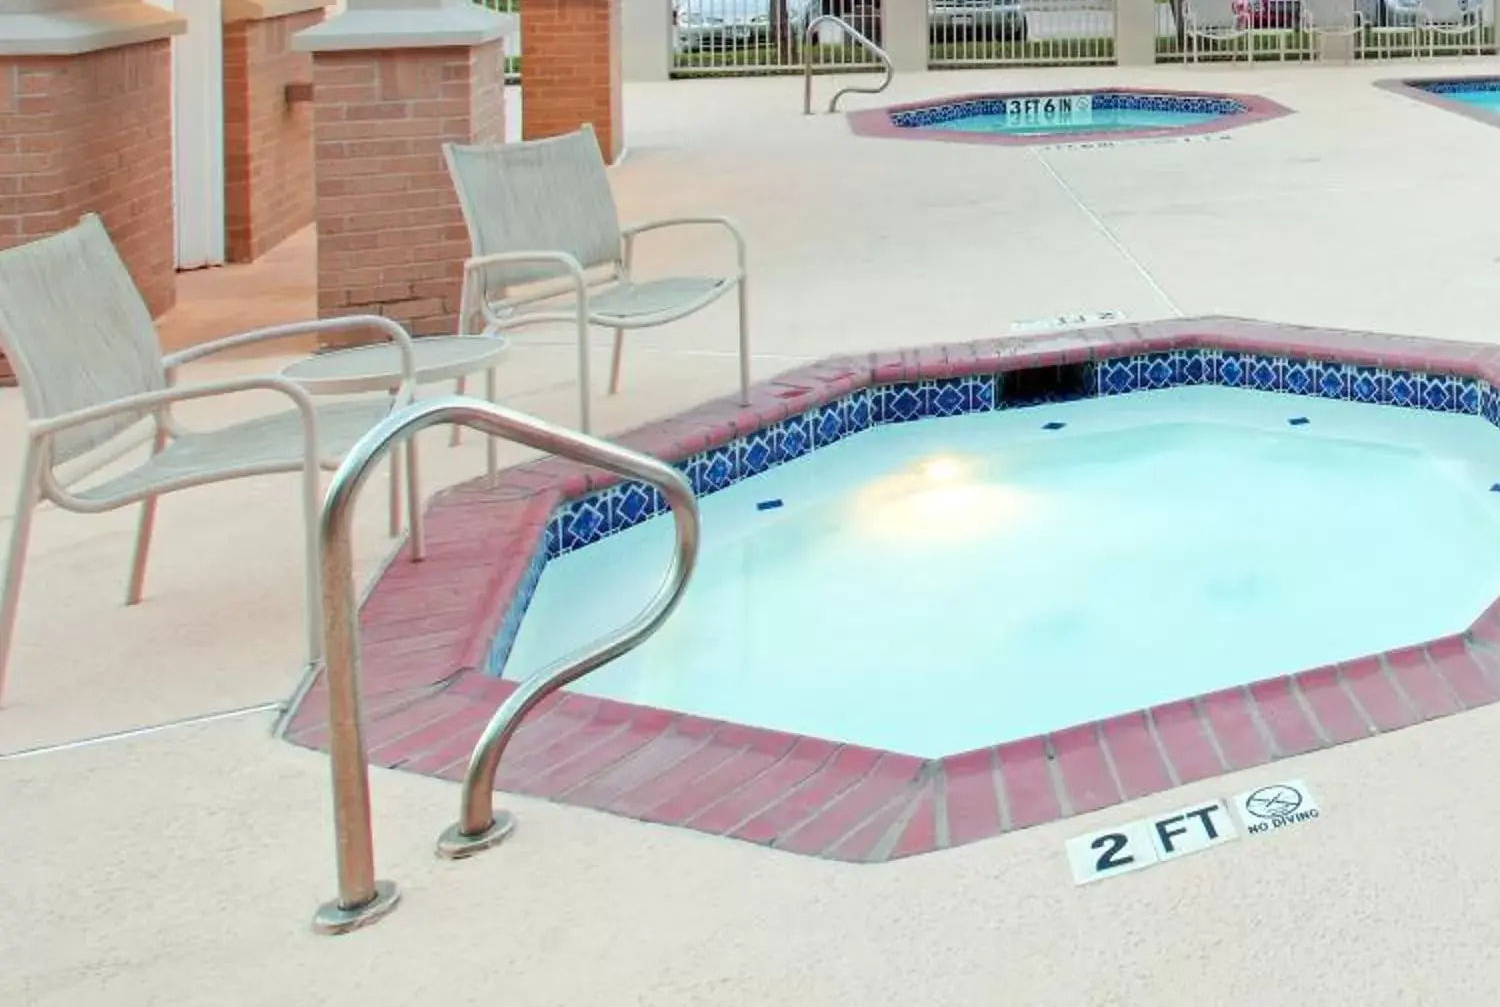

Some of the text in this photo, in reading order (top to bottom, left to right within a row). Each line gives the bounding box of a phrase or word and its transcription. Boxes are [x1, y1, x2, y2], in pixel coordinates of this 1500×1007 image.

[1010, 98, 1072, 113] 3 FT 6 IN
[1247, 807, 1320, 835] NO DIVING
[1090, 803, 1220, 872] 2 FT
